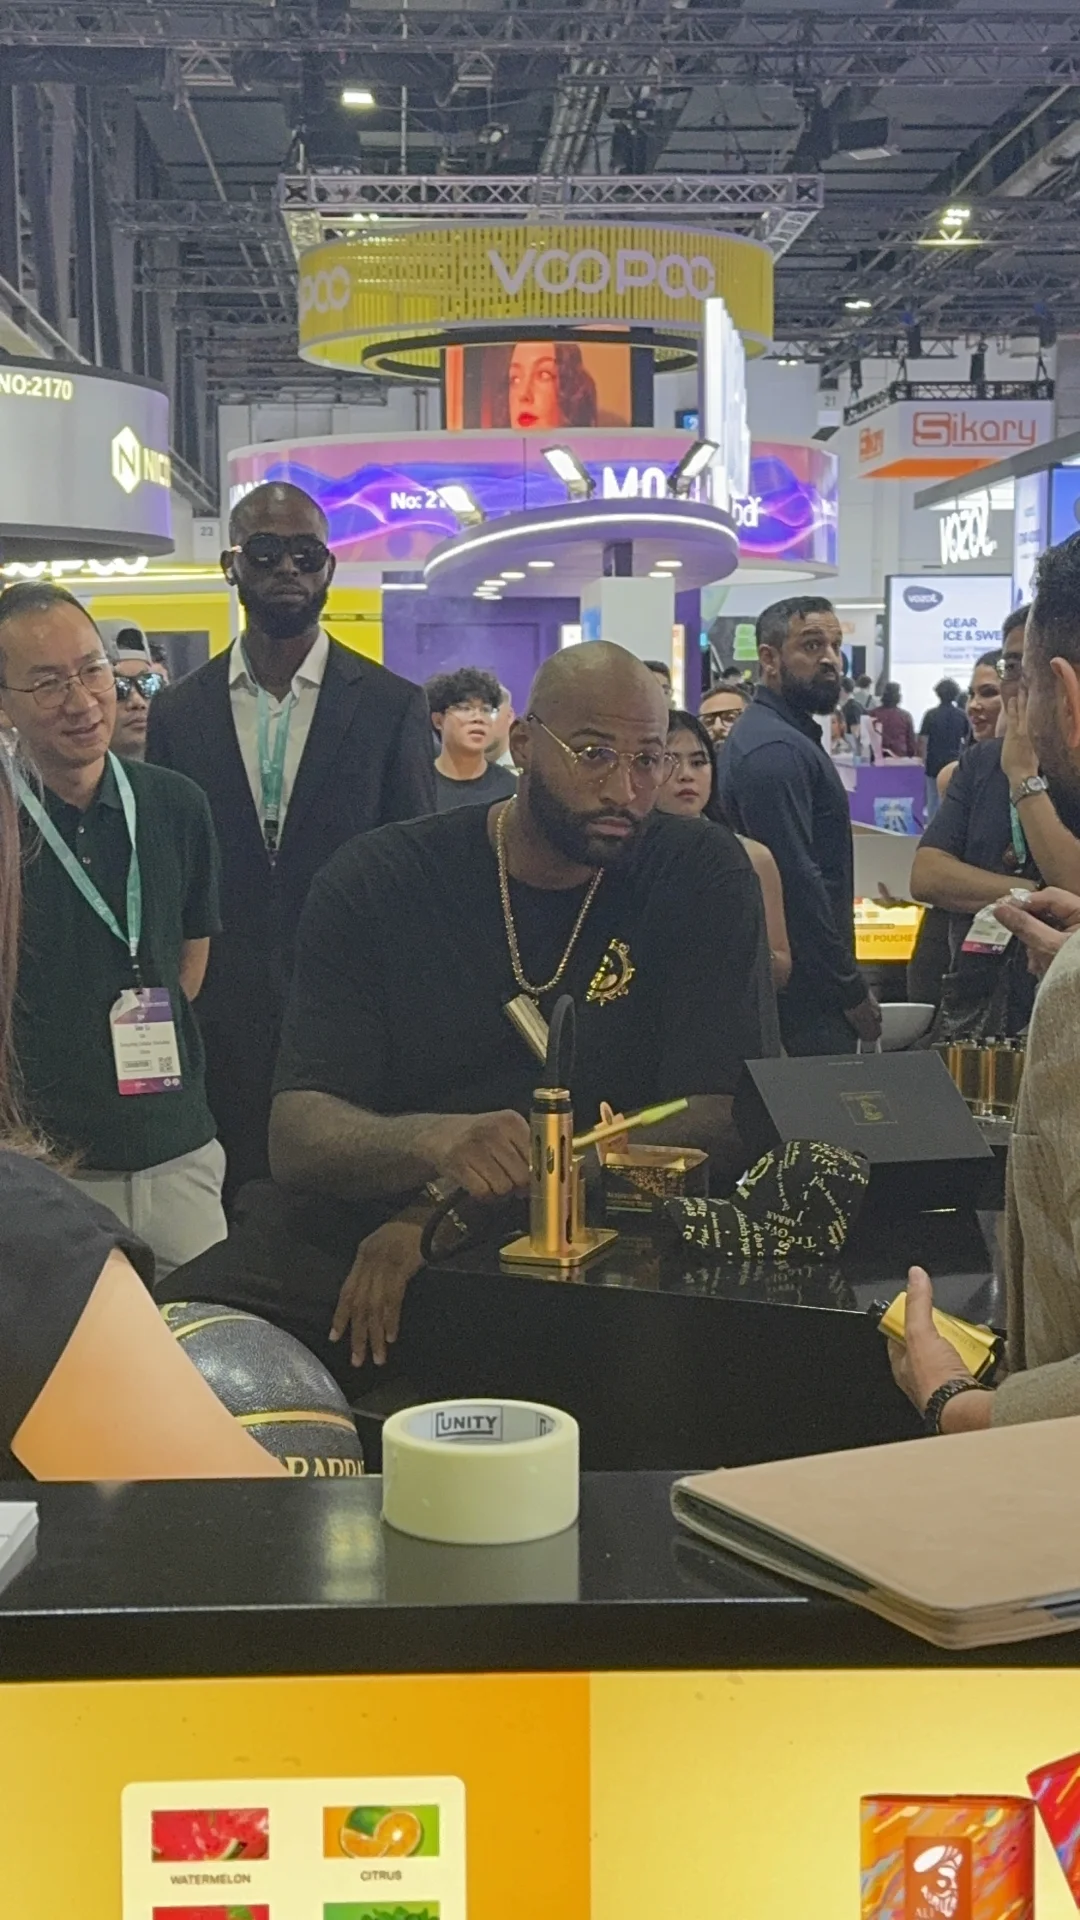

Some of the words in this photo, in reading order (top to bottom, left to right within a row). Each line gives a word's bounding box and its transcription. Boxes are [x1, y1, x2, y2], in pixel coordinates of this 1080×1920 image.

[912, 411, 1037, 447] Sikary
[943, 618, 977, 628] GEAR
[943, 631, 963, 641] ICE
[965, 630, 973, 641] &
[441, 1416, 497, 1430] UNITY
[170, 1873, 252, 1885] WATERMELON
[360, 1870, 402, 1882] CITRUS
